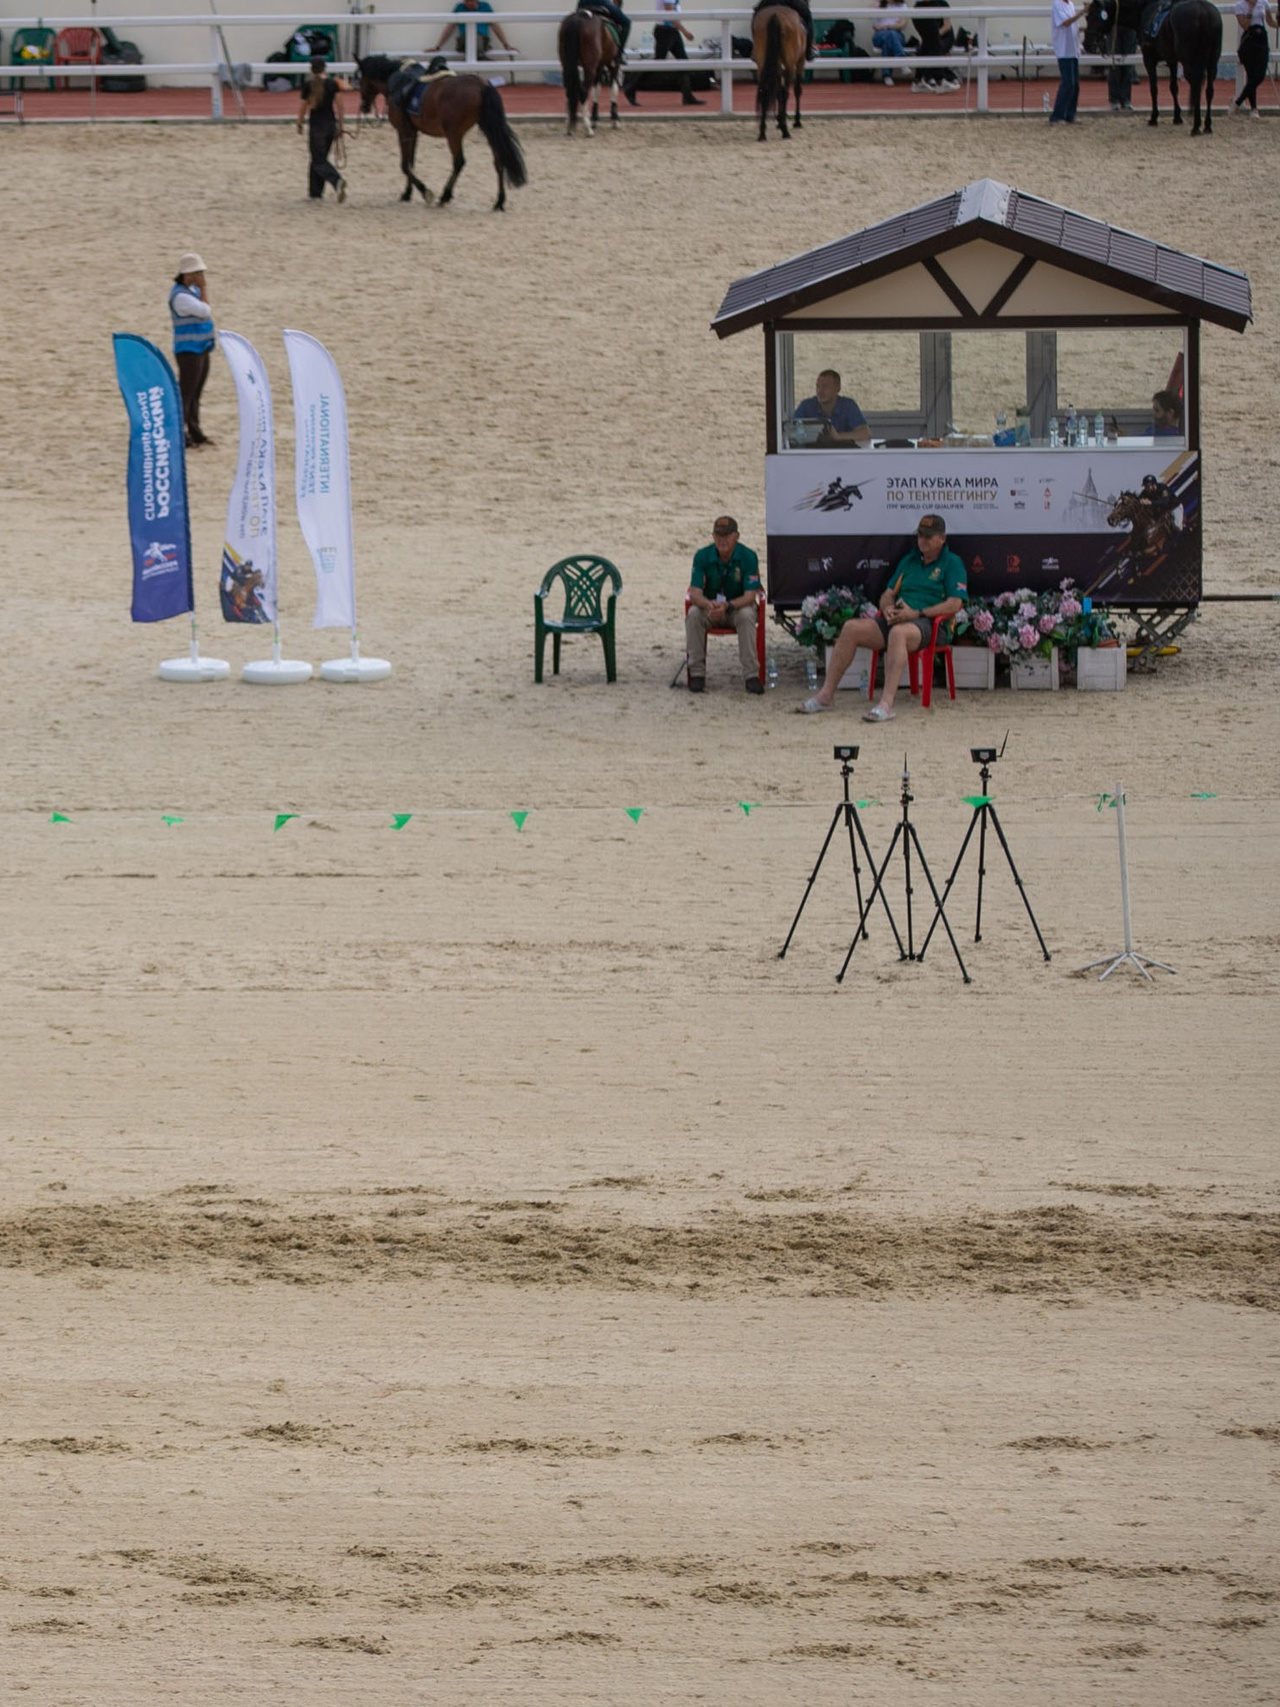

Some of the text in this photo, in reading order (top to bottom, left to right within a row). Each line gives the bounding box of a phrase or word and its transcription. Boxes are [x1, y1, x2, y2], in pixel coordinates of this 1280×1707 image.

[886, 477, 999, 488] ЭТАП КУБКА МИРА
[886, 490, 998, 501] ПО ТЕНТПЕГГИНГУ
